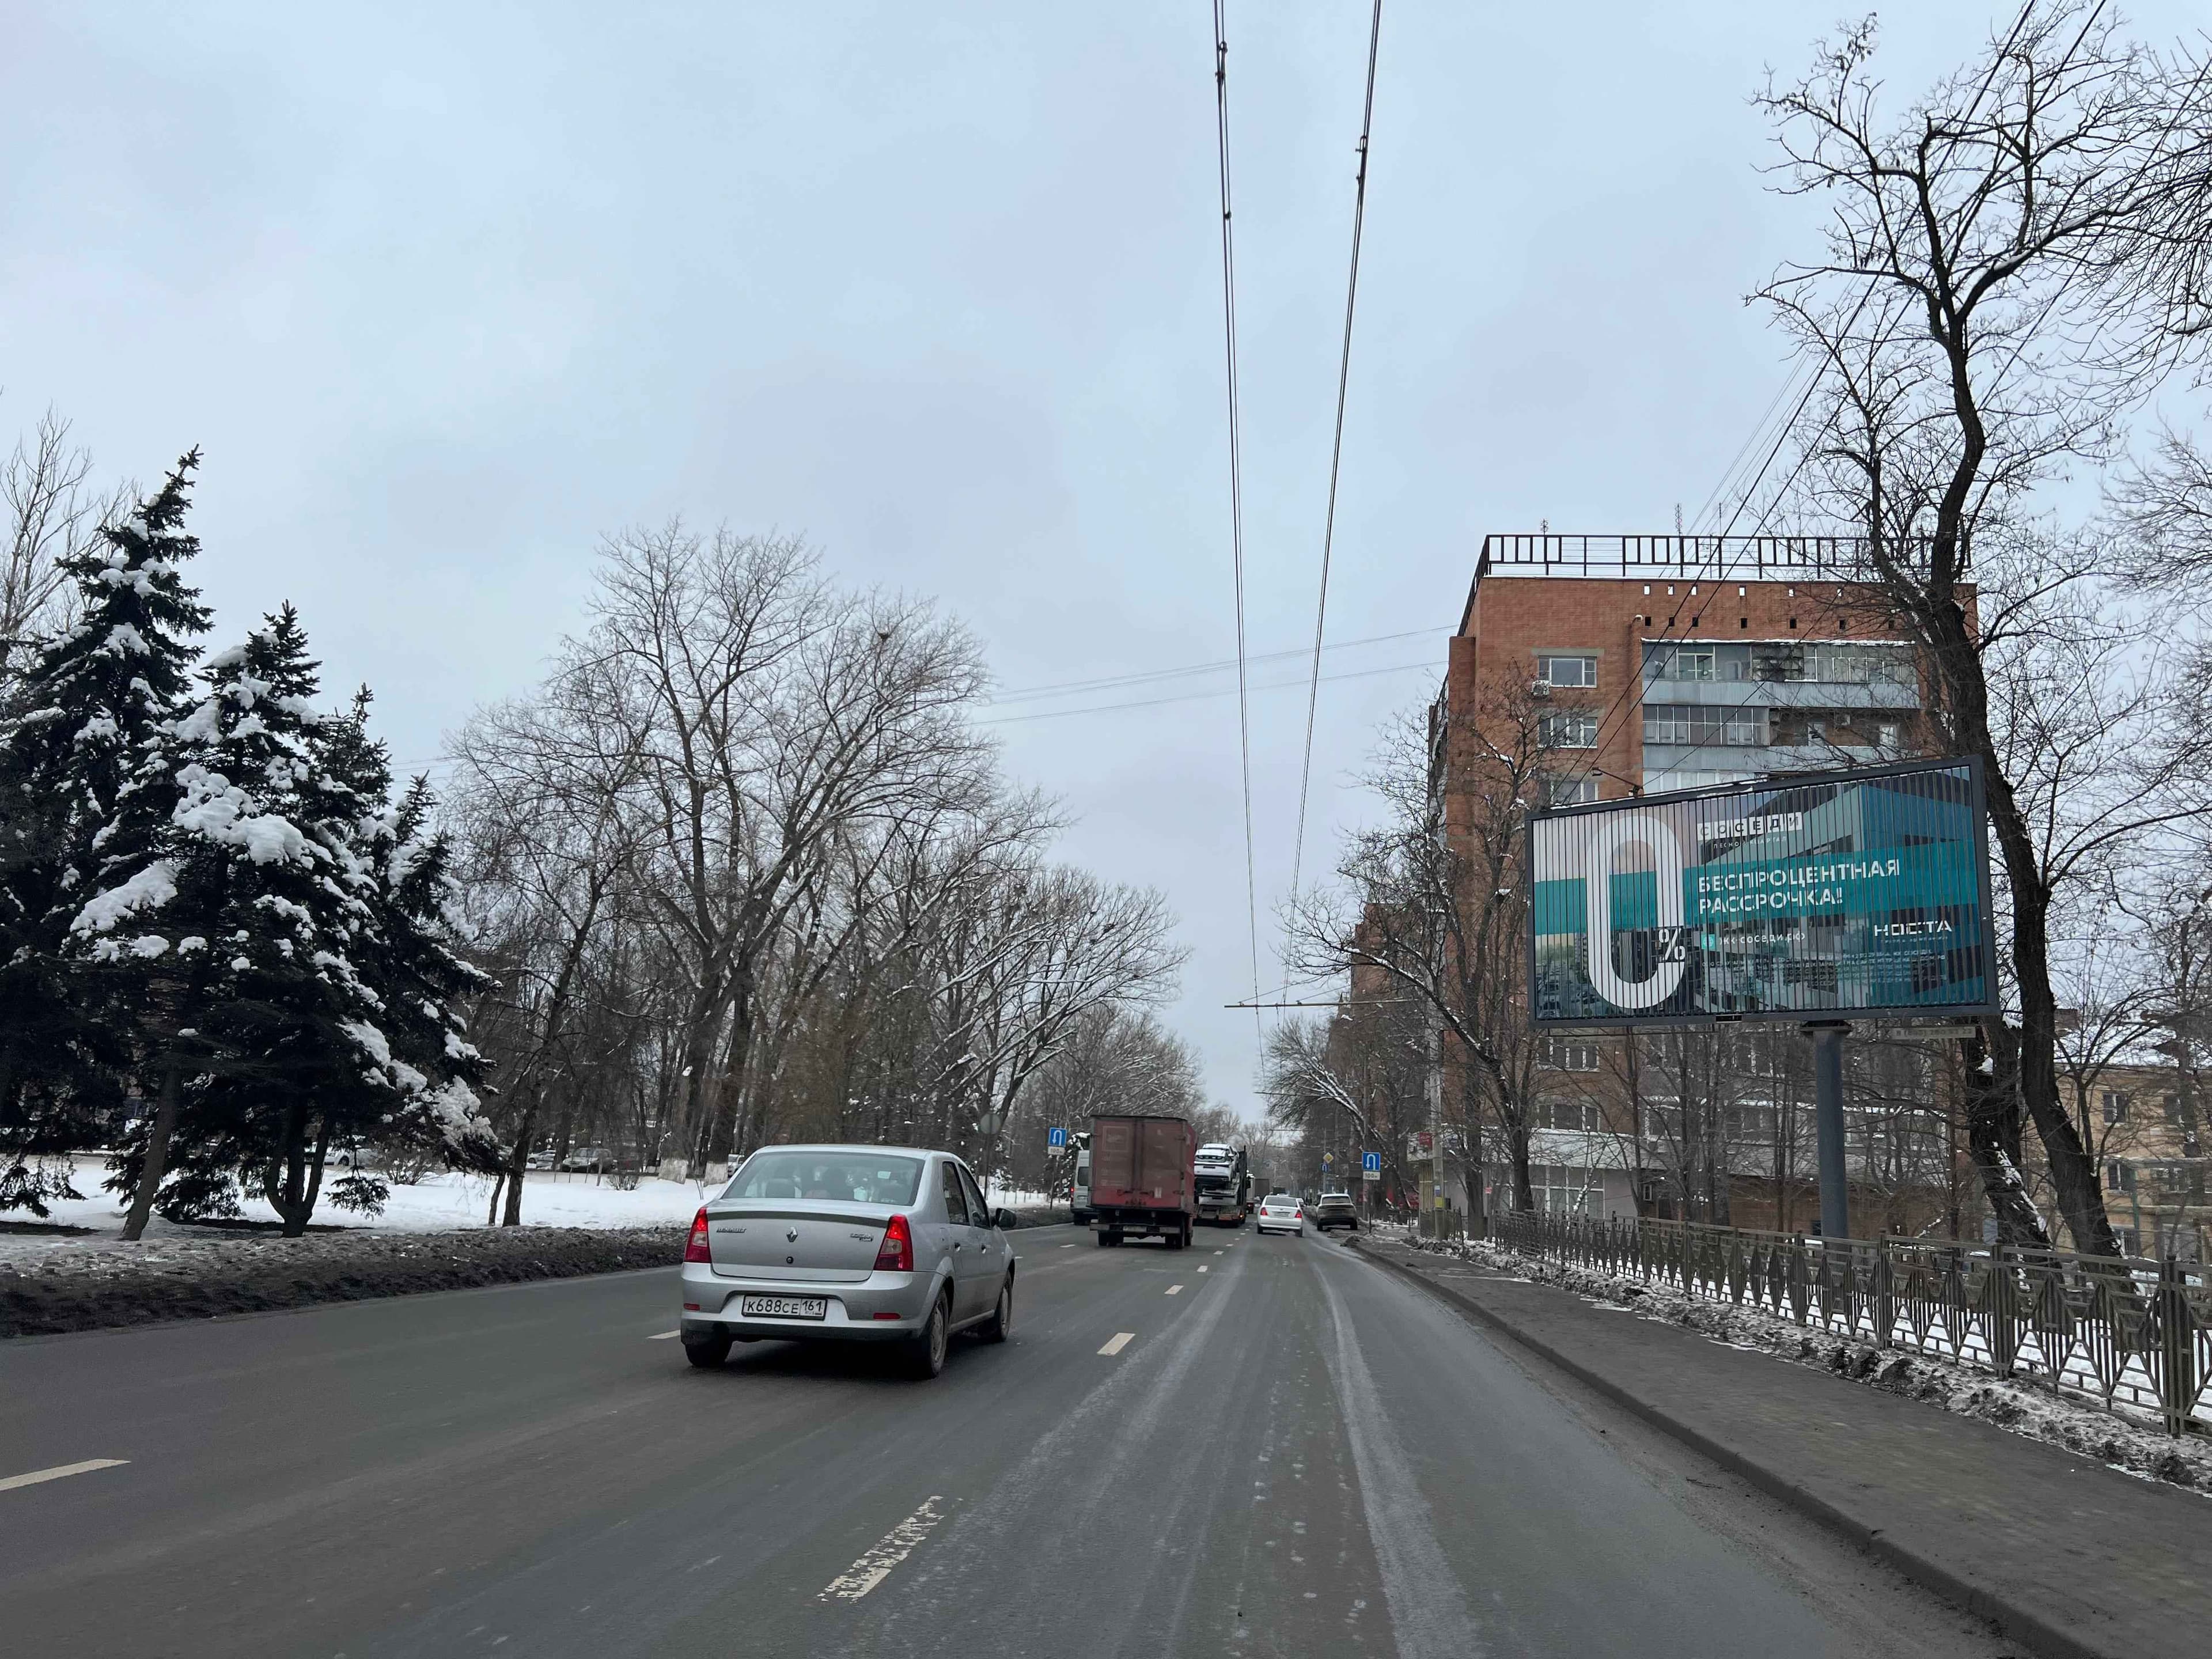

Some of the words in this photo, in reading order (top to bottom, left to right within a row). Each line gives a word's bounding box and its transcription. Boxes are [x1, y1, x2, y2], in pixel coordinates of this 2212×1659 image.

[1700, 816, 1800, 836] СОСЕДИ
[1699, 859, 1900, 893] БЕСПРОЦЕНТНАЯ
[1699, 887, 1843, 914] РАССРОЧКА!
[1874, 921, 1952, 937] НОСТА
[802, 1300, 822, 1312] 161
